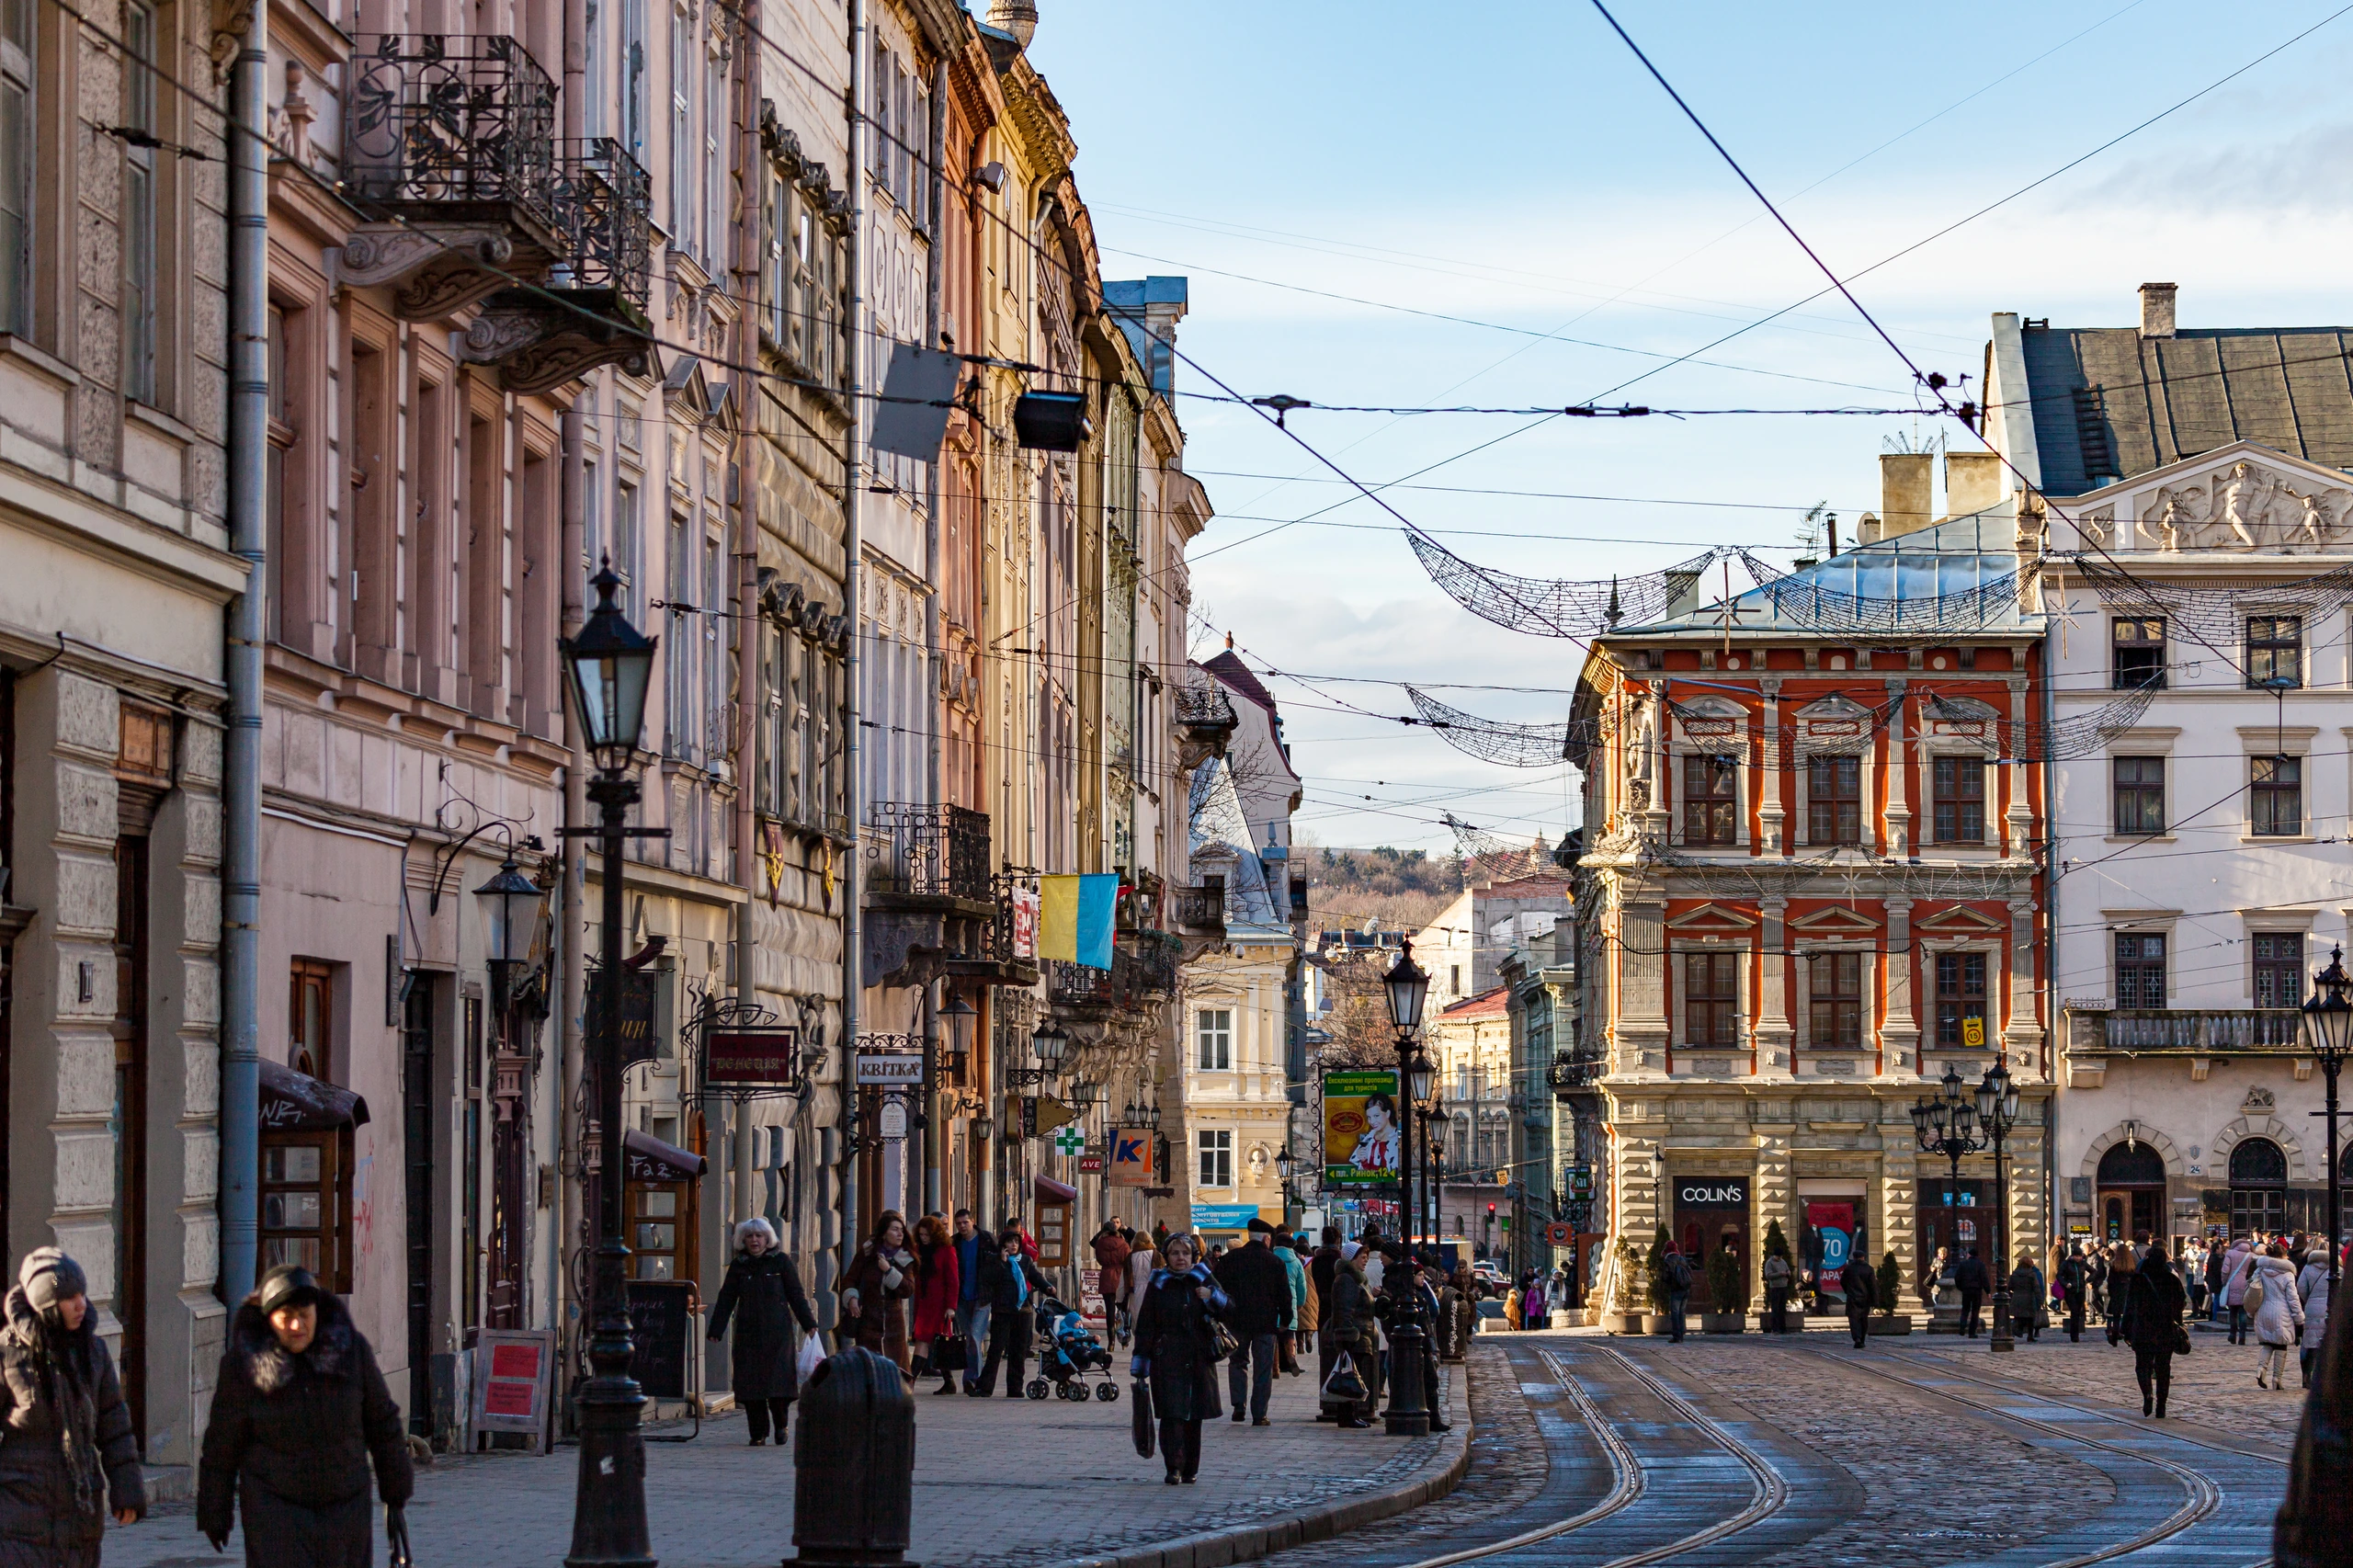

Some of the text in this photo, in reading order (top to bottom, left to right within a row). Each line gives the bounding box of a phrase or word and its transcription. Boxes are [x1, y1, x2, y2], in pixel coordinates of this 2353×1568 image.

[859, 1062, 920, 1076] КВІТКА
[1327, 1075, 1394, 1085] Ексклюзивні пропозиції
[1355, 1085, 1378, 1093] туристів
[2190, 1165, 2200, 1174] 24
[1682, 1185, 1742, 1202] COLIN'S
[1820, 1270, 1844, 1280] АРА
